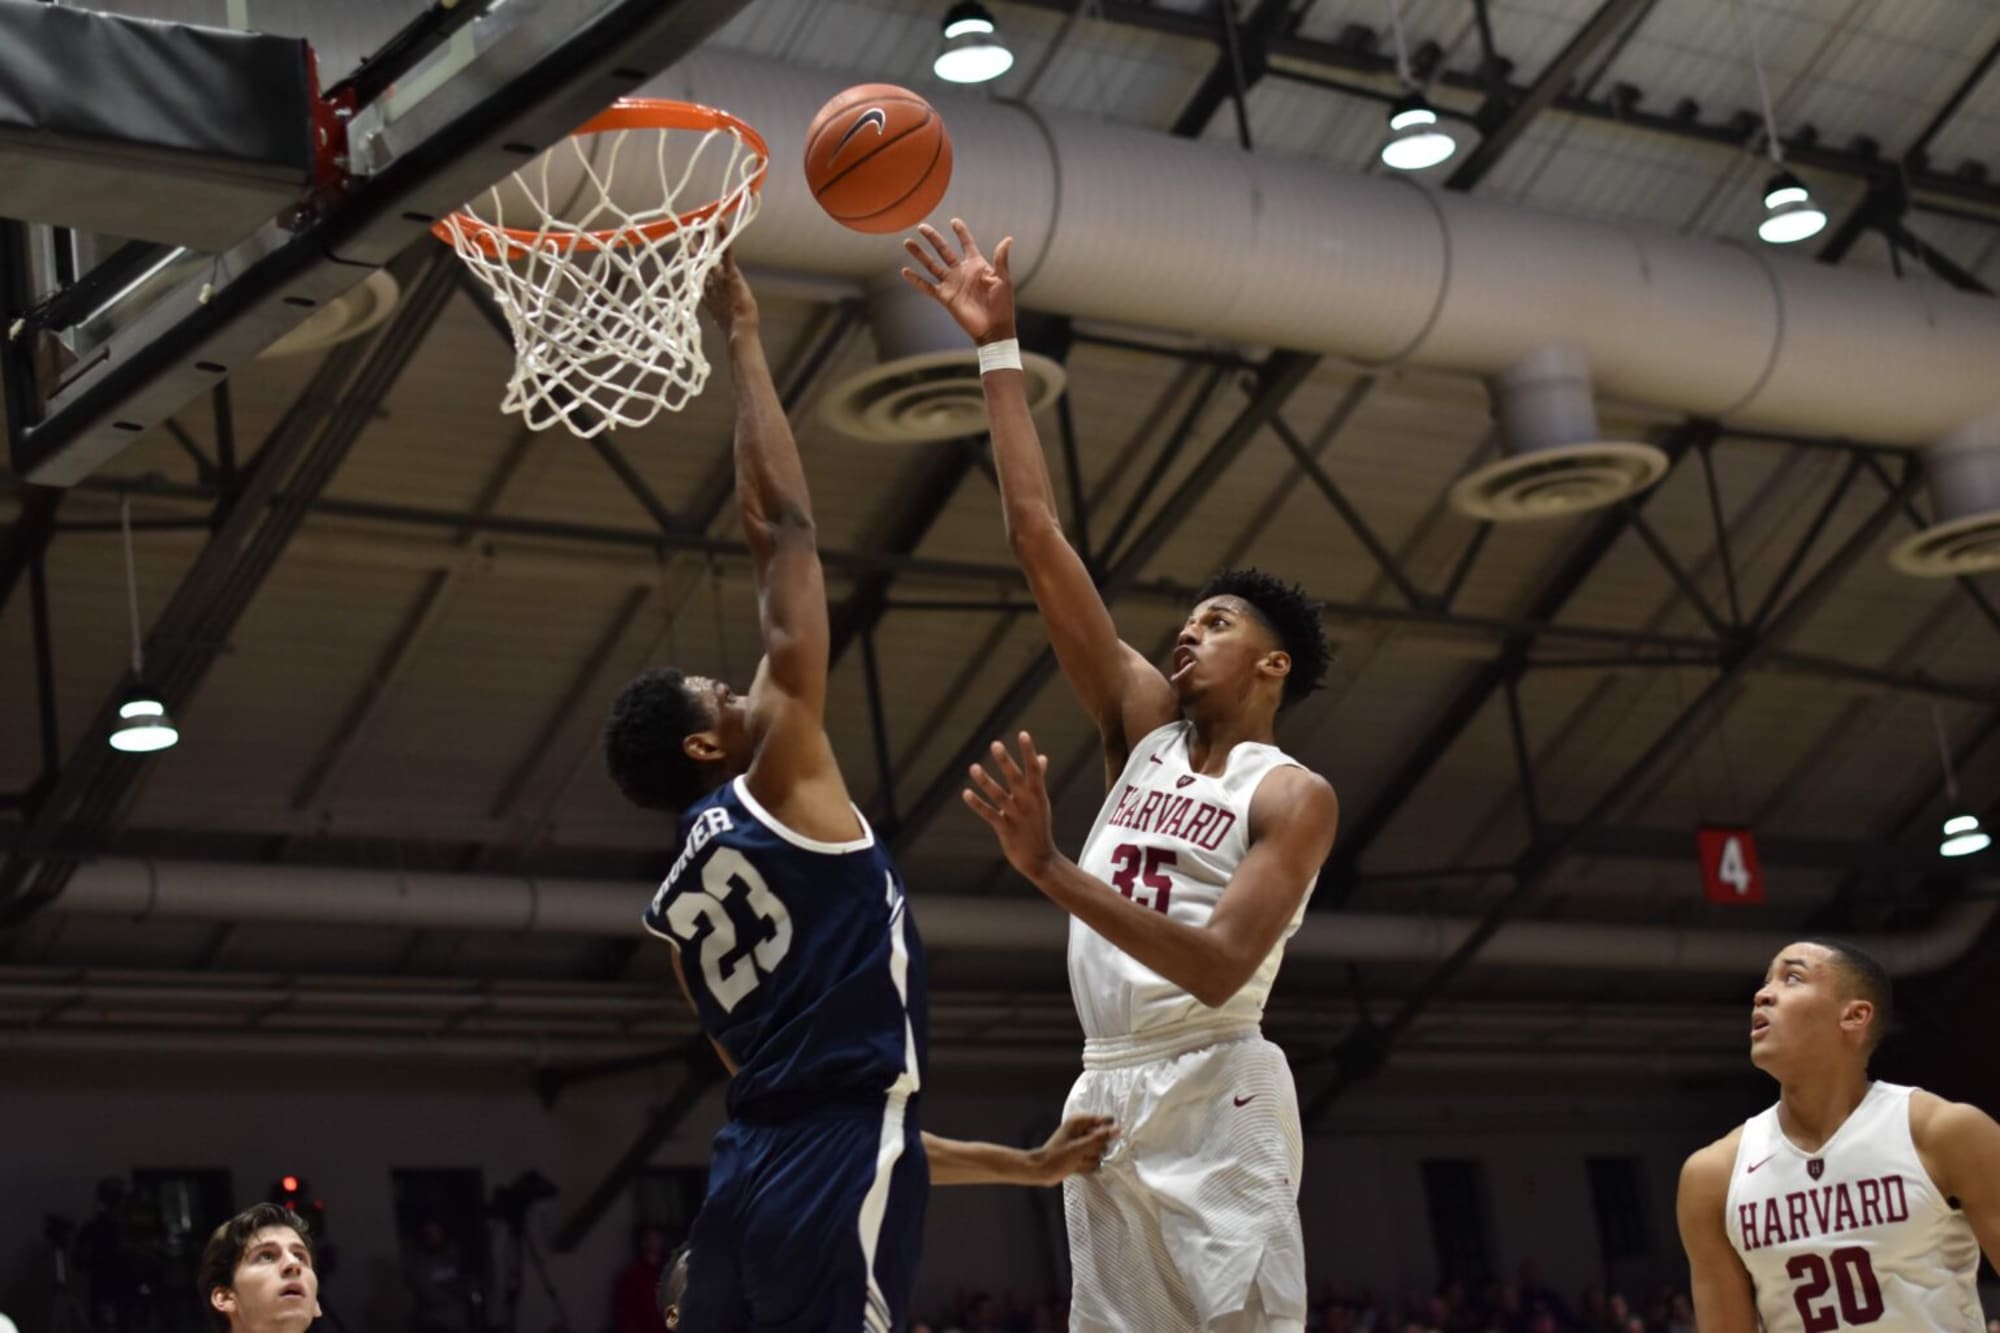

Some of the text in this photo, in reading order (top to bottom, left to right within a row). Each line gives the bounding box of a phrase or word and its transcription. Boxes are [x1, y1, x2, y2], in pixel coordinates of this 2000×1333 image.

[1108, 785, 1236, 851] HARVARD
[1111, 843, 1177, 914] 35
[1719, 837, 1751, 895] 4
[665, 846, 793, 1014] 23
[1739, 1174, 1909, 1252] HARVARD
[1785, 1246, 1885, 1333] 20
